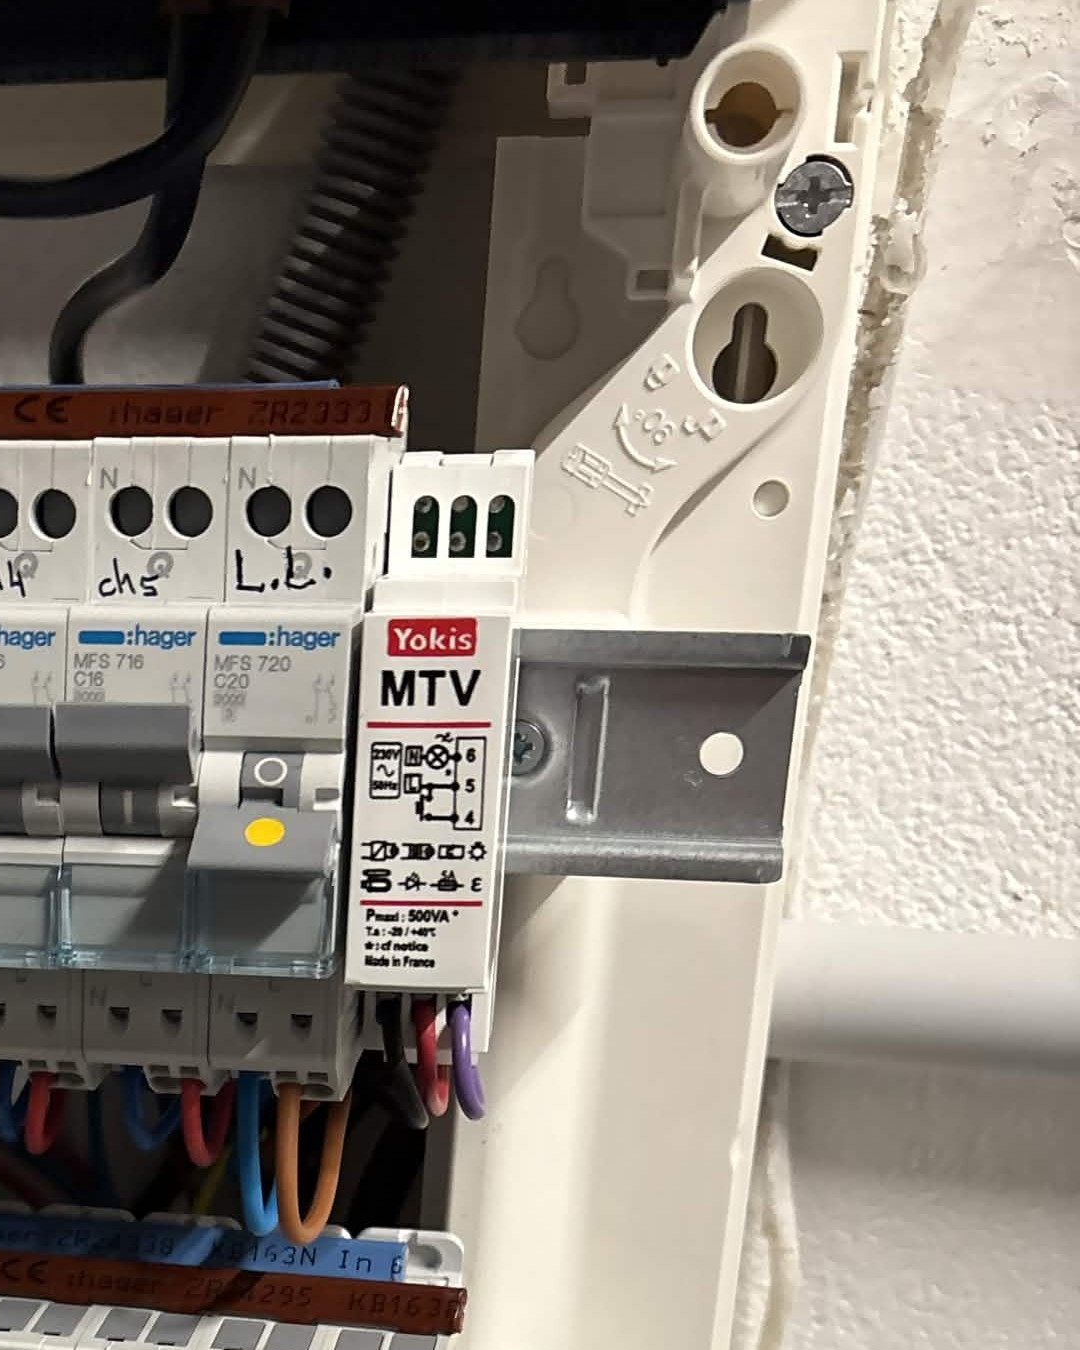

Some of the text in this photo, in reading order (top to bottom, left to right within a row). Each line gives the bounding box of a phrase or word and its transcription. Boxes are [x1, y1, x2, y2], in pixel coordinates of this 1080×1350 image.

[100, 467, 119, 489] N
[238, 467, 257, 489] N
[392, 627, 474, 651] Yokis
[73, 653, 145, 670] MFS 716
[214, 656, 292, 672] MFS 720
[381, 669, 481, 706] MTV
[465, 748, 477, 763] 6
[465, 778, 476, 793] 5
[464, 810, 475, 825] 4
[393, 941, 429, 952] notice
[403, 955, 436, 968] France
